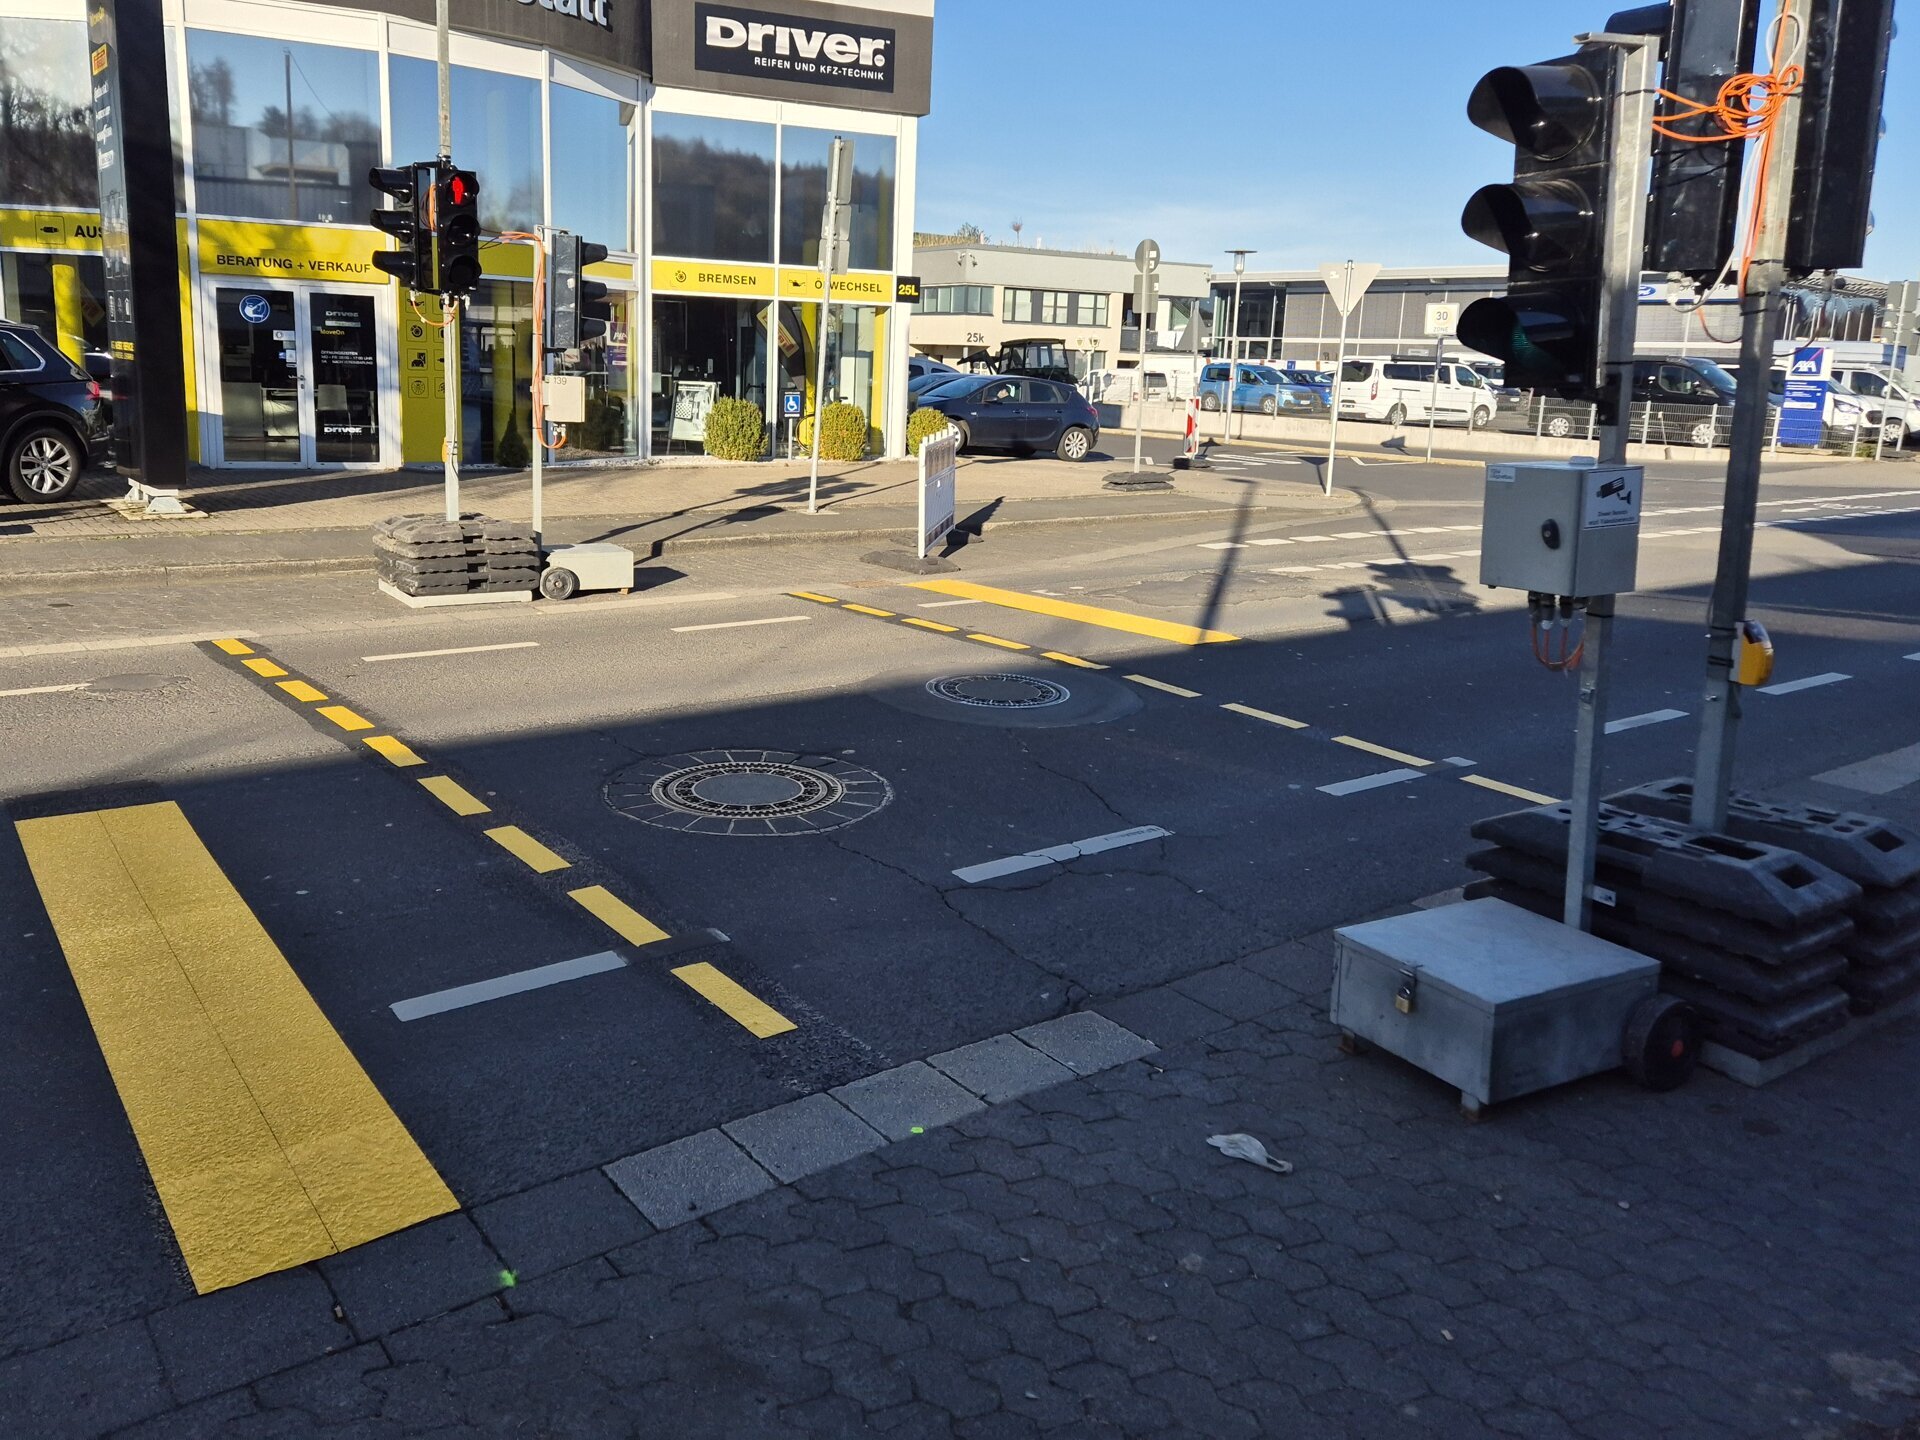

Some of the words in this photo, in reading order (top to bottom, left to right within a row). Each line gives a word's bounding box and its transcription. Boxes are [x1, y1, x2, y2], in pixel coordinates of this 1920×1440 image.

[754, 57, 791, 70] REIFEN
[794, 62, 816, 72] UND
[819, 65, 885, 81] KFZ-TECHNIK
[216, 254, 293, 269] BERATUNG
[308, 260, 371, 273] VERKAUF
[698, 272, 756, 285] BREMSEN
[814, 277, 883, 293] ÖWECHSEL
[898, 284, 919, 296] 25L
[1436, 311, 1449, 321] 30
[966, 332, 985, 344] 25k
[1791, 360, 1817, 372] AXA
[553, 376, 568, 386] 139
